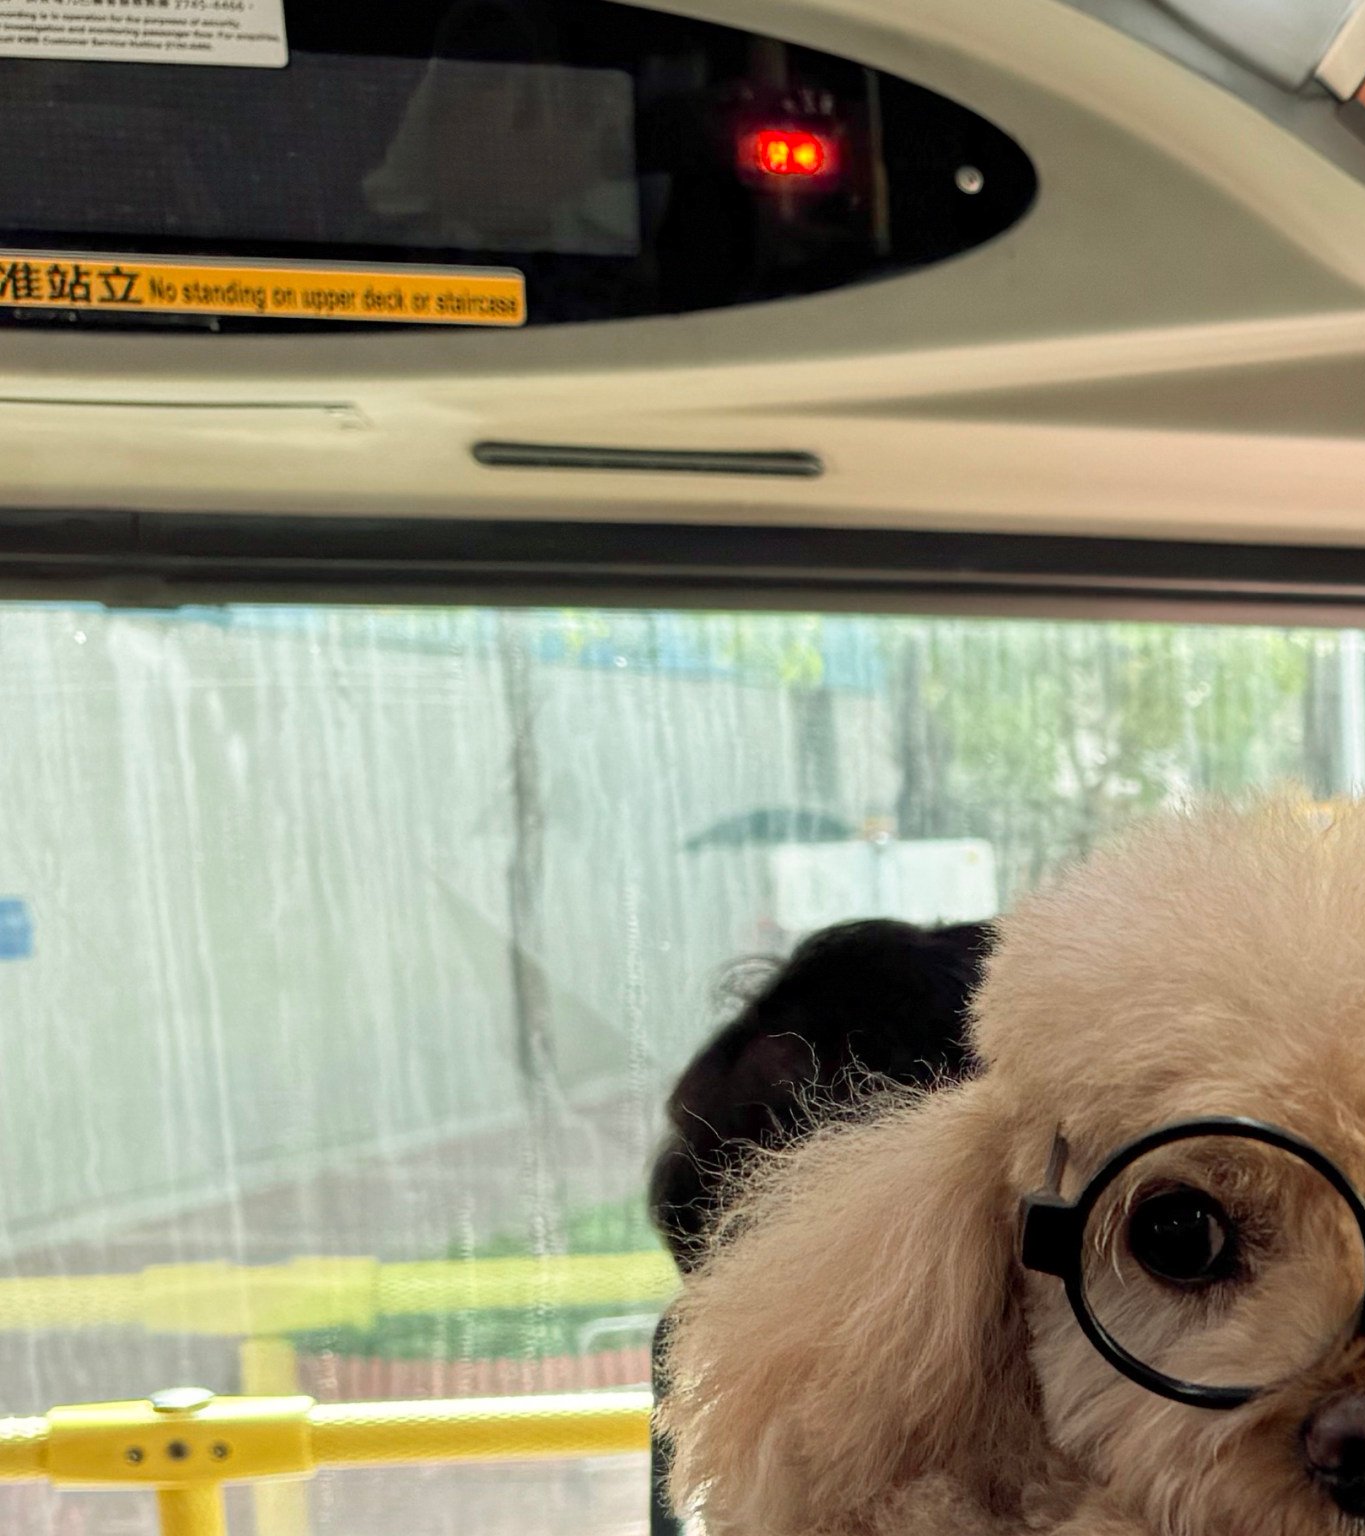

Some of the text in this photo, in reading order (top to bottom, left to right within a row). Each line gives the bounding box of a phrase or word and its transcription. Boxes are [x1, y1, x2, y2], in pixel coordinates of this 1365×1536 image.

[0, 262, 142, 305] 准站立
[150, 276, 517, 317] No standing on upper deck or staircase
